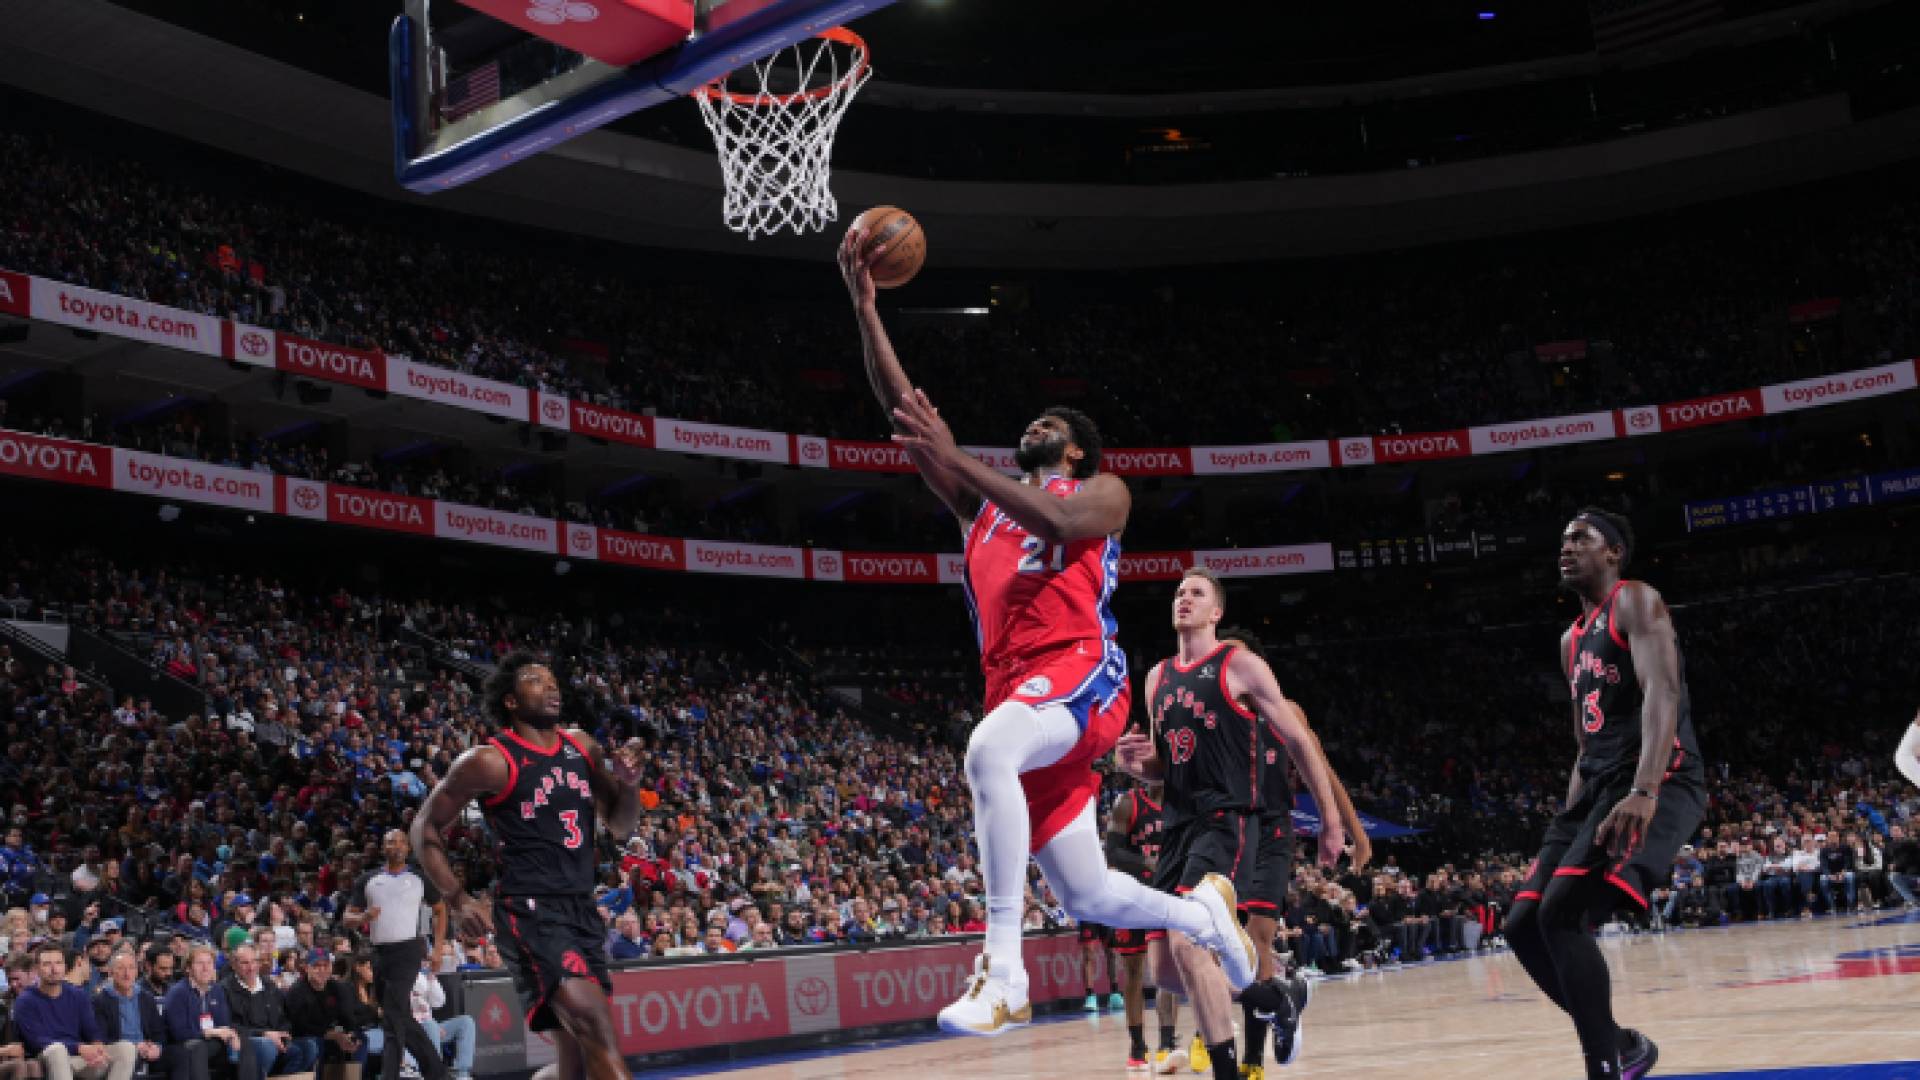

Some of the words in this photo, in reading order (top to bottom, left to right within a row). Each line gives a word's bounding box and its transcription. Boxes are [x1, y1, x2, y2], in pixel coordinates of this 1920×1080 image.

[59, 292, 198, 340] toyota.com
[284, 342, 376, 380] TOYOTA
[407, 369, 512, 408] toyota.com
[1783, 370, 1896, 403] toyota.com
[575, 406, 647, 439] TOYOTA
[1666, 397, 1753, 424] TOYOTA
[673, 426, 772, 453] toyota.com
[1379, 436, 1460, 456] TOYOTA
[1489, 419, 1595, 446] toyota.com
[0, 439, 97, 476] OYOTA
[834, 445, 911, 465] TOYOTA
[1104, 453, 1183, 469] TOYOTA
[1210, 448, 1311, 469] toyota.com
[128, 459, 260, 499] toyota.com
[334, 493, 423, 525] TOYOTA
[445, 509, 548, 541] toyota.com
[603, 537, 676, 562] TOYOTA
[696, 547, 795, 569] toyota.com
[1018, 535, 1063, 571] 21
[1116, 558, 1184, 574] OYOTA
[1204, 552, 1305, 572] toyota.com
[847, 558, 929, 576] TOYOTA
[1571, 650, 1621, 700] APTORS
[1154, 686, 1217, 733] APTORS
[1164, 727, 1197, 765] 19
[521, 766, 592, 819] RAPTOR
[559, 809, 583, 849] 3
[1036, 950, 1116, 987] TOY
[853, 963, 968, 1009] TOYOTA
[612, 982, 771, 1037] TOYOTA
